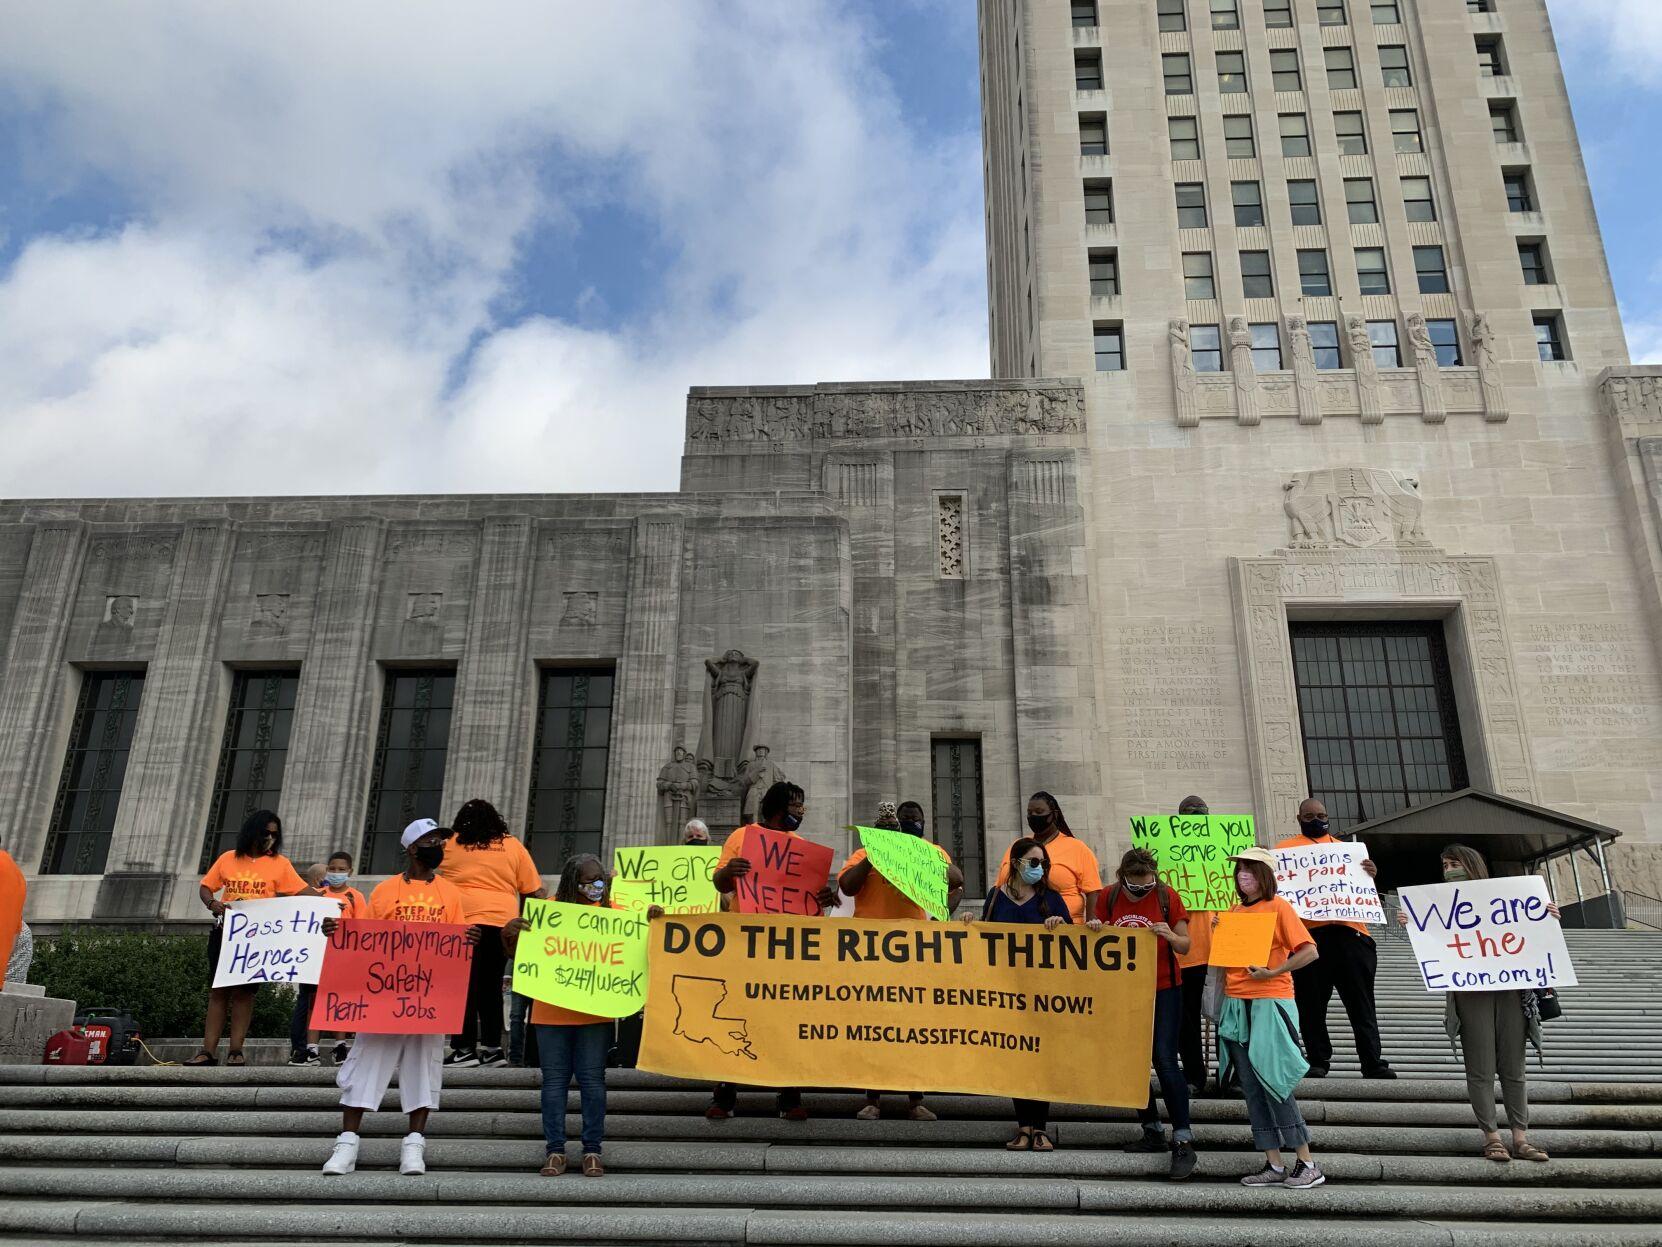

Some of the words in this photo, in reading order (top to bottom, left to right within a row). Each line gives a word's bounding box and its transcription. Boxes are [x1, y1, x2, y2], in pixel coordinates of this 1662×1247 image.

[1130, 816, 1160, 838] We
[617, 850, 658, 881] We
[672, 856, 720, 882] are
[760, 834, 804, 877] WE
[1170, 844, 1216, 862] serve
[1274, 852, 1352, 872] iticians
[226, 880, 250, 888] STEP
[252, 881, 266, 889] UP
[1277, 870, 1298, 882] et
[645, 881, 688, 905] the
[740, 872, 821, 916] NEED
[1276, 880, 1378, 905] orporations
[1304, 893, 1352, 908] bailed
[396, 906, 424, 916] STEP
[429, 907, 442, 917] UP
[527, 902, 562, 930] We
[578, 912, 650, 940] cannot
[1402, 888, 1481, 932] We
[1490, 896, 1549, 925] are
[228, 913, 283, 942] Pass
[290, 911, 320, 934] th
[228, 943, 309, 974] Heroes
[544, 936, 625, 966] SURVIVE
[663, 922, 726, 958] DO
[740, 925, 822, 961] THE
[838, 928, 968, 964] RIGHT
[980, 932, 1138, 972] THING!
[1447, 930, 1525, 959] the
[247, 965, 298, 982] Act
[366, 962, 434, 998] Safety.
[518, 962, 539, 978] on
[1421, 952, 1556, 989] Economy!
[392, 996, 437, 1020] Jobs.
[745, 982, 926, 1004] UNEMPLOYMENT
[932, 988, 1027, 1010] BENEFITS
[1034, 994, 1093, 1014] NOW!
[798, 1024, 839, 1040] END
[846, 1024, 1040, 1052] MISCLASSIFICATION!
